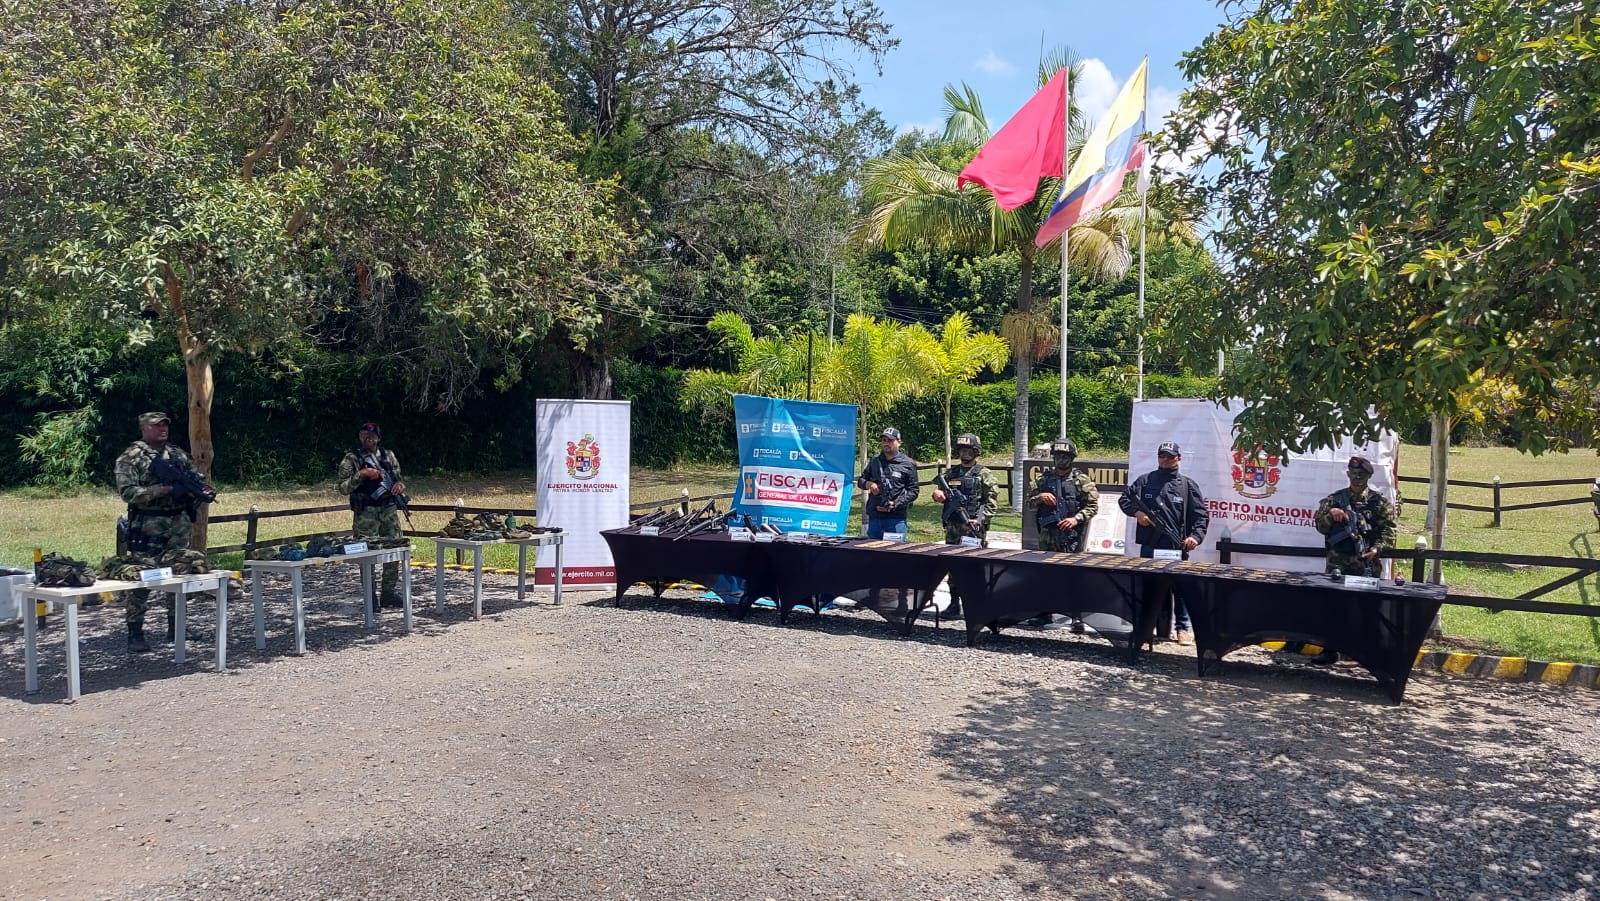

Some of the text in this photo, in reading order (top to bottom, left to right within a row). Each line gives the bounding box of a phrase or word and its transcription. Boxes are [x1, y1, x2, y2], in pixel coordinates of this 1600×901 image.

[759, 473, 838, 491] FISCALÍA
[1088, 467, 1128, 486] MILI
[1201, 498, 1251, 513] ÉRCITO
[1255, 505, 1318, 519] NACION
[1206, 511, 1228, 519] TRIA
[1233, 513, 1268, 523] HONOR
[550, 570, 615, 579] ww.ejercito.mil.co
